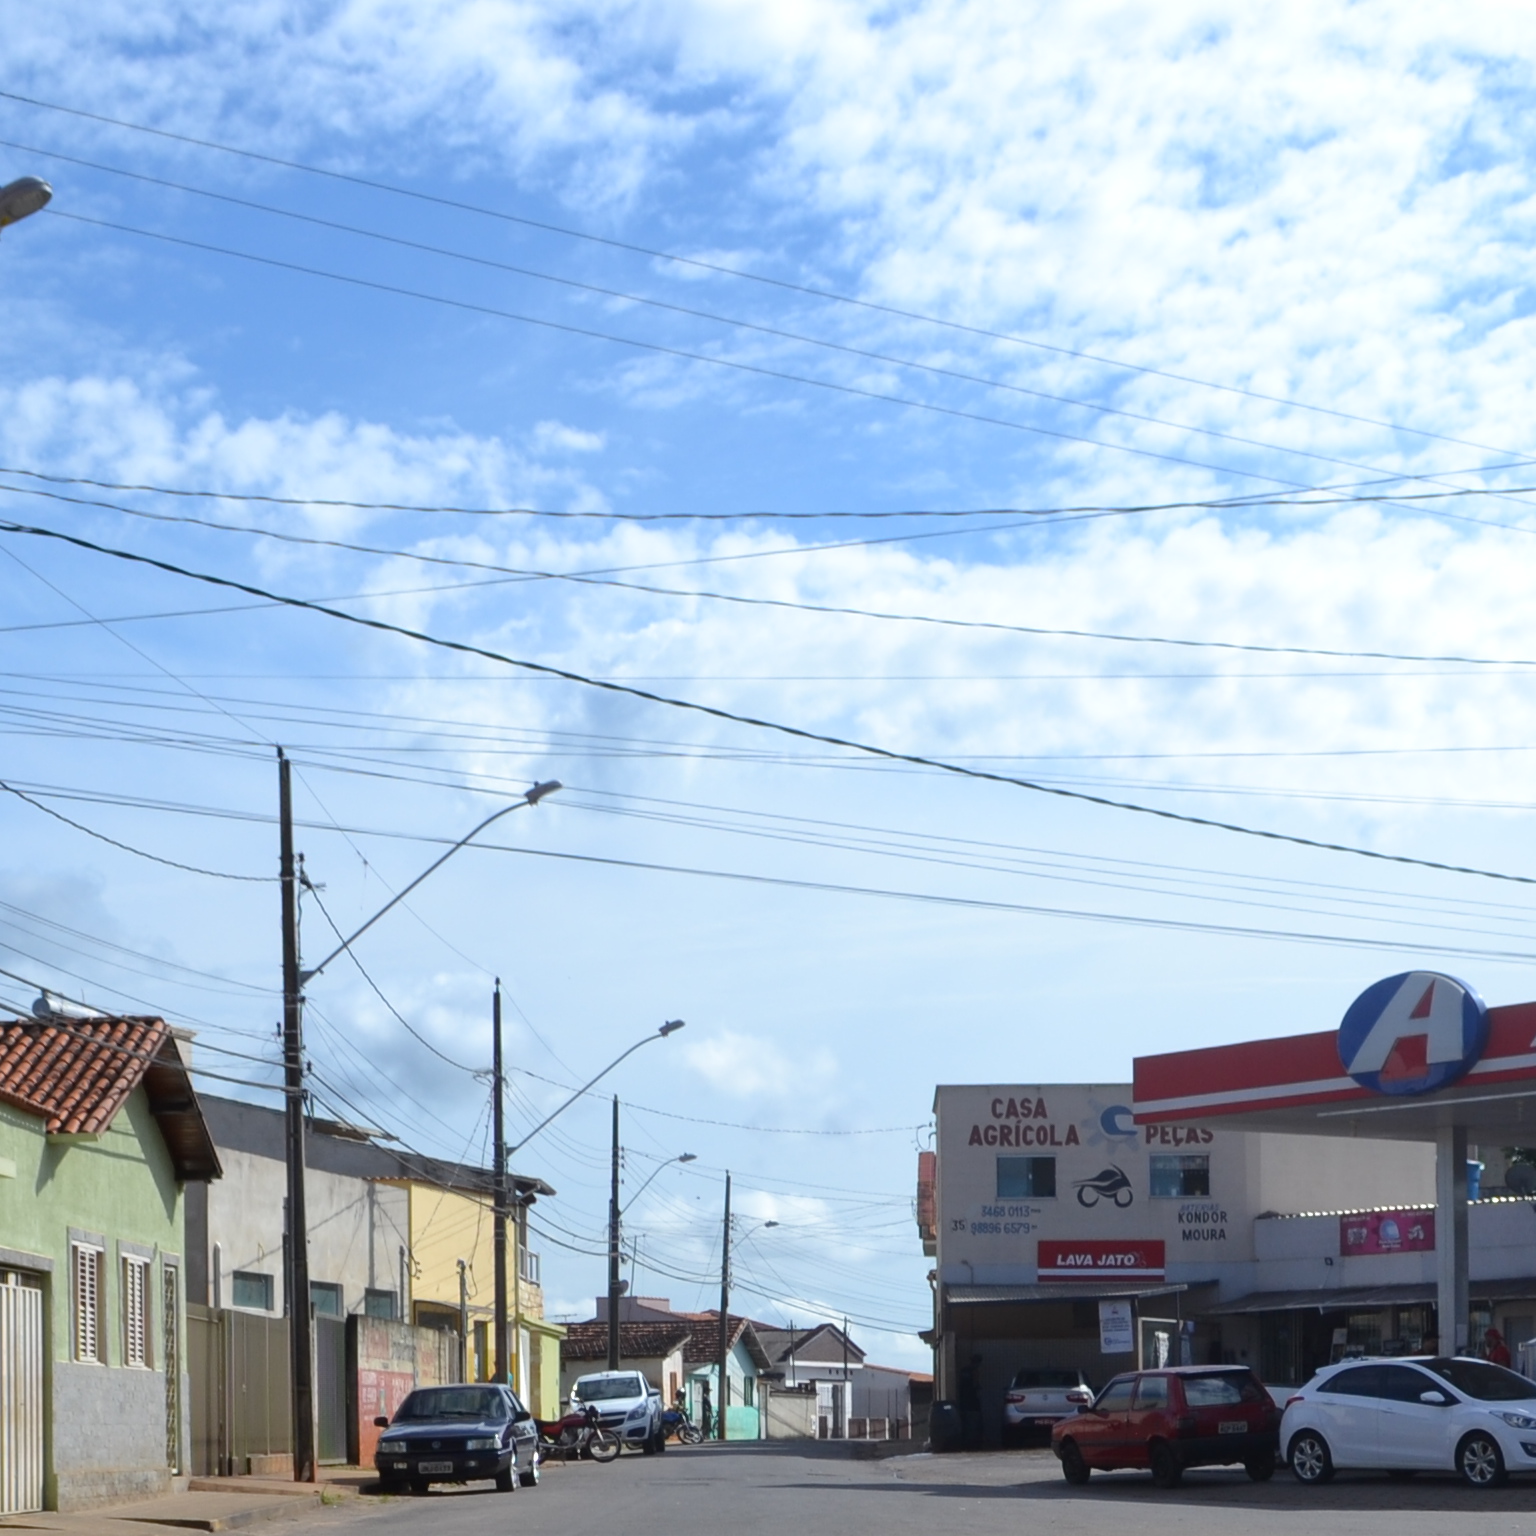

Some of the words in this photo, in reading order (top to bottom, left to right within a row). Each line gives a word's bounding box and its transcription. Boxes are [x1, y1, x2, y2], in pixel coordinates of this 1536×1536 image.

[991, 1097, 1048, 1119] CASA
[968, 1119, 1080, 1147] AGRÍCOLA
[1145, 1123, 1214, 1147] PEÇAS
[981, 1206, 1005, 1218] 3468
[1008, 1205, 1030, 1218] 0113
[1177, 1210, 1228, 1224] KONDOR
[1182, 1228, 1227, 1241] MOURA
[1056, 1254, 1094, 1267] LAVA
[1097, 1253, 1135, 1267] JATO
